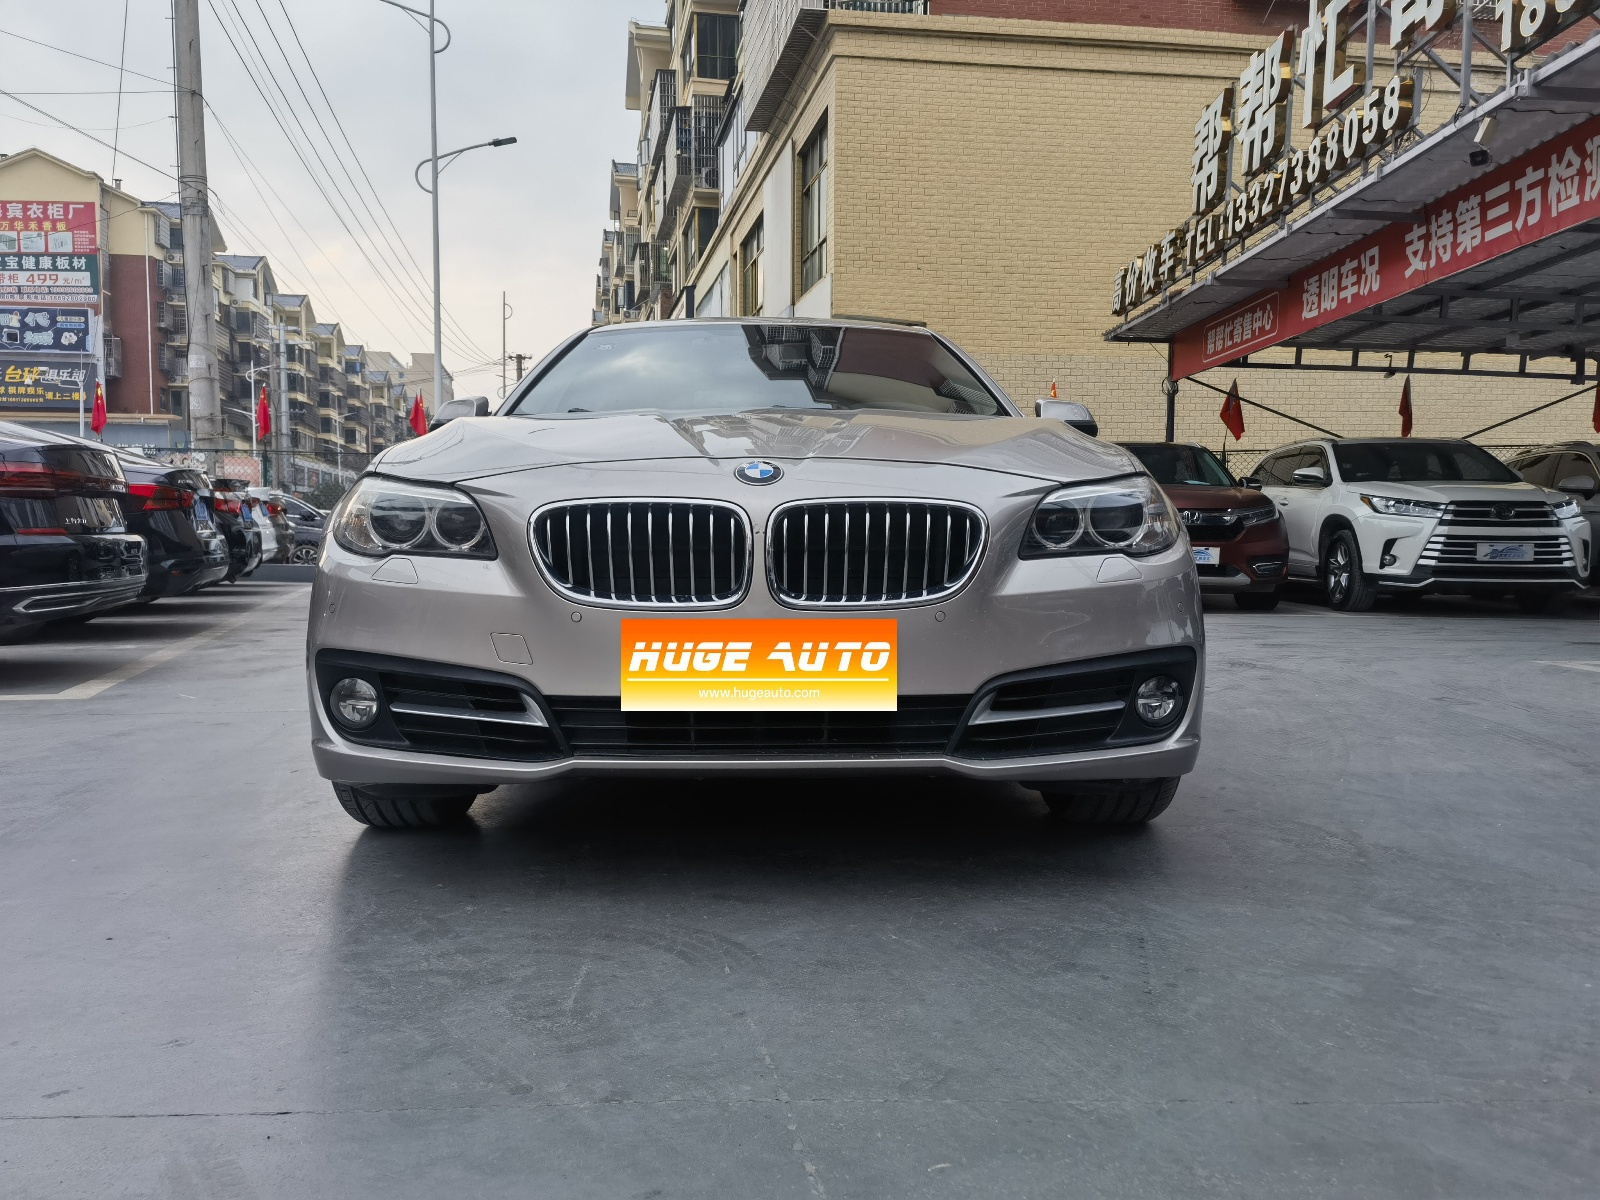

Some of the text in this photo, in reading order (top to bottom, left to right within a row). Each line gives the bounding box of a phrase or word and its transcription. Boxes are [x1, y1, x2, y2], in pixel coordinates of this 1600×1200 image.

[0, 203, 84, 219] 宾衣柜厂
[1, 221, 66, 231] 万华禾香板
[0, 256, 86, 270] 宝健康板材
[26, 273, 59, 284] 499
[1111, 229, 1176, 315] 高价收车
[1301, 245, 1380, 320] 透明车况
[1207, 303, 1273, 355] 帮帮忙寄售中心
[0, 365, 86, 382] 台球俱乐部
